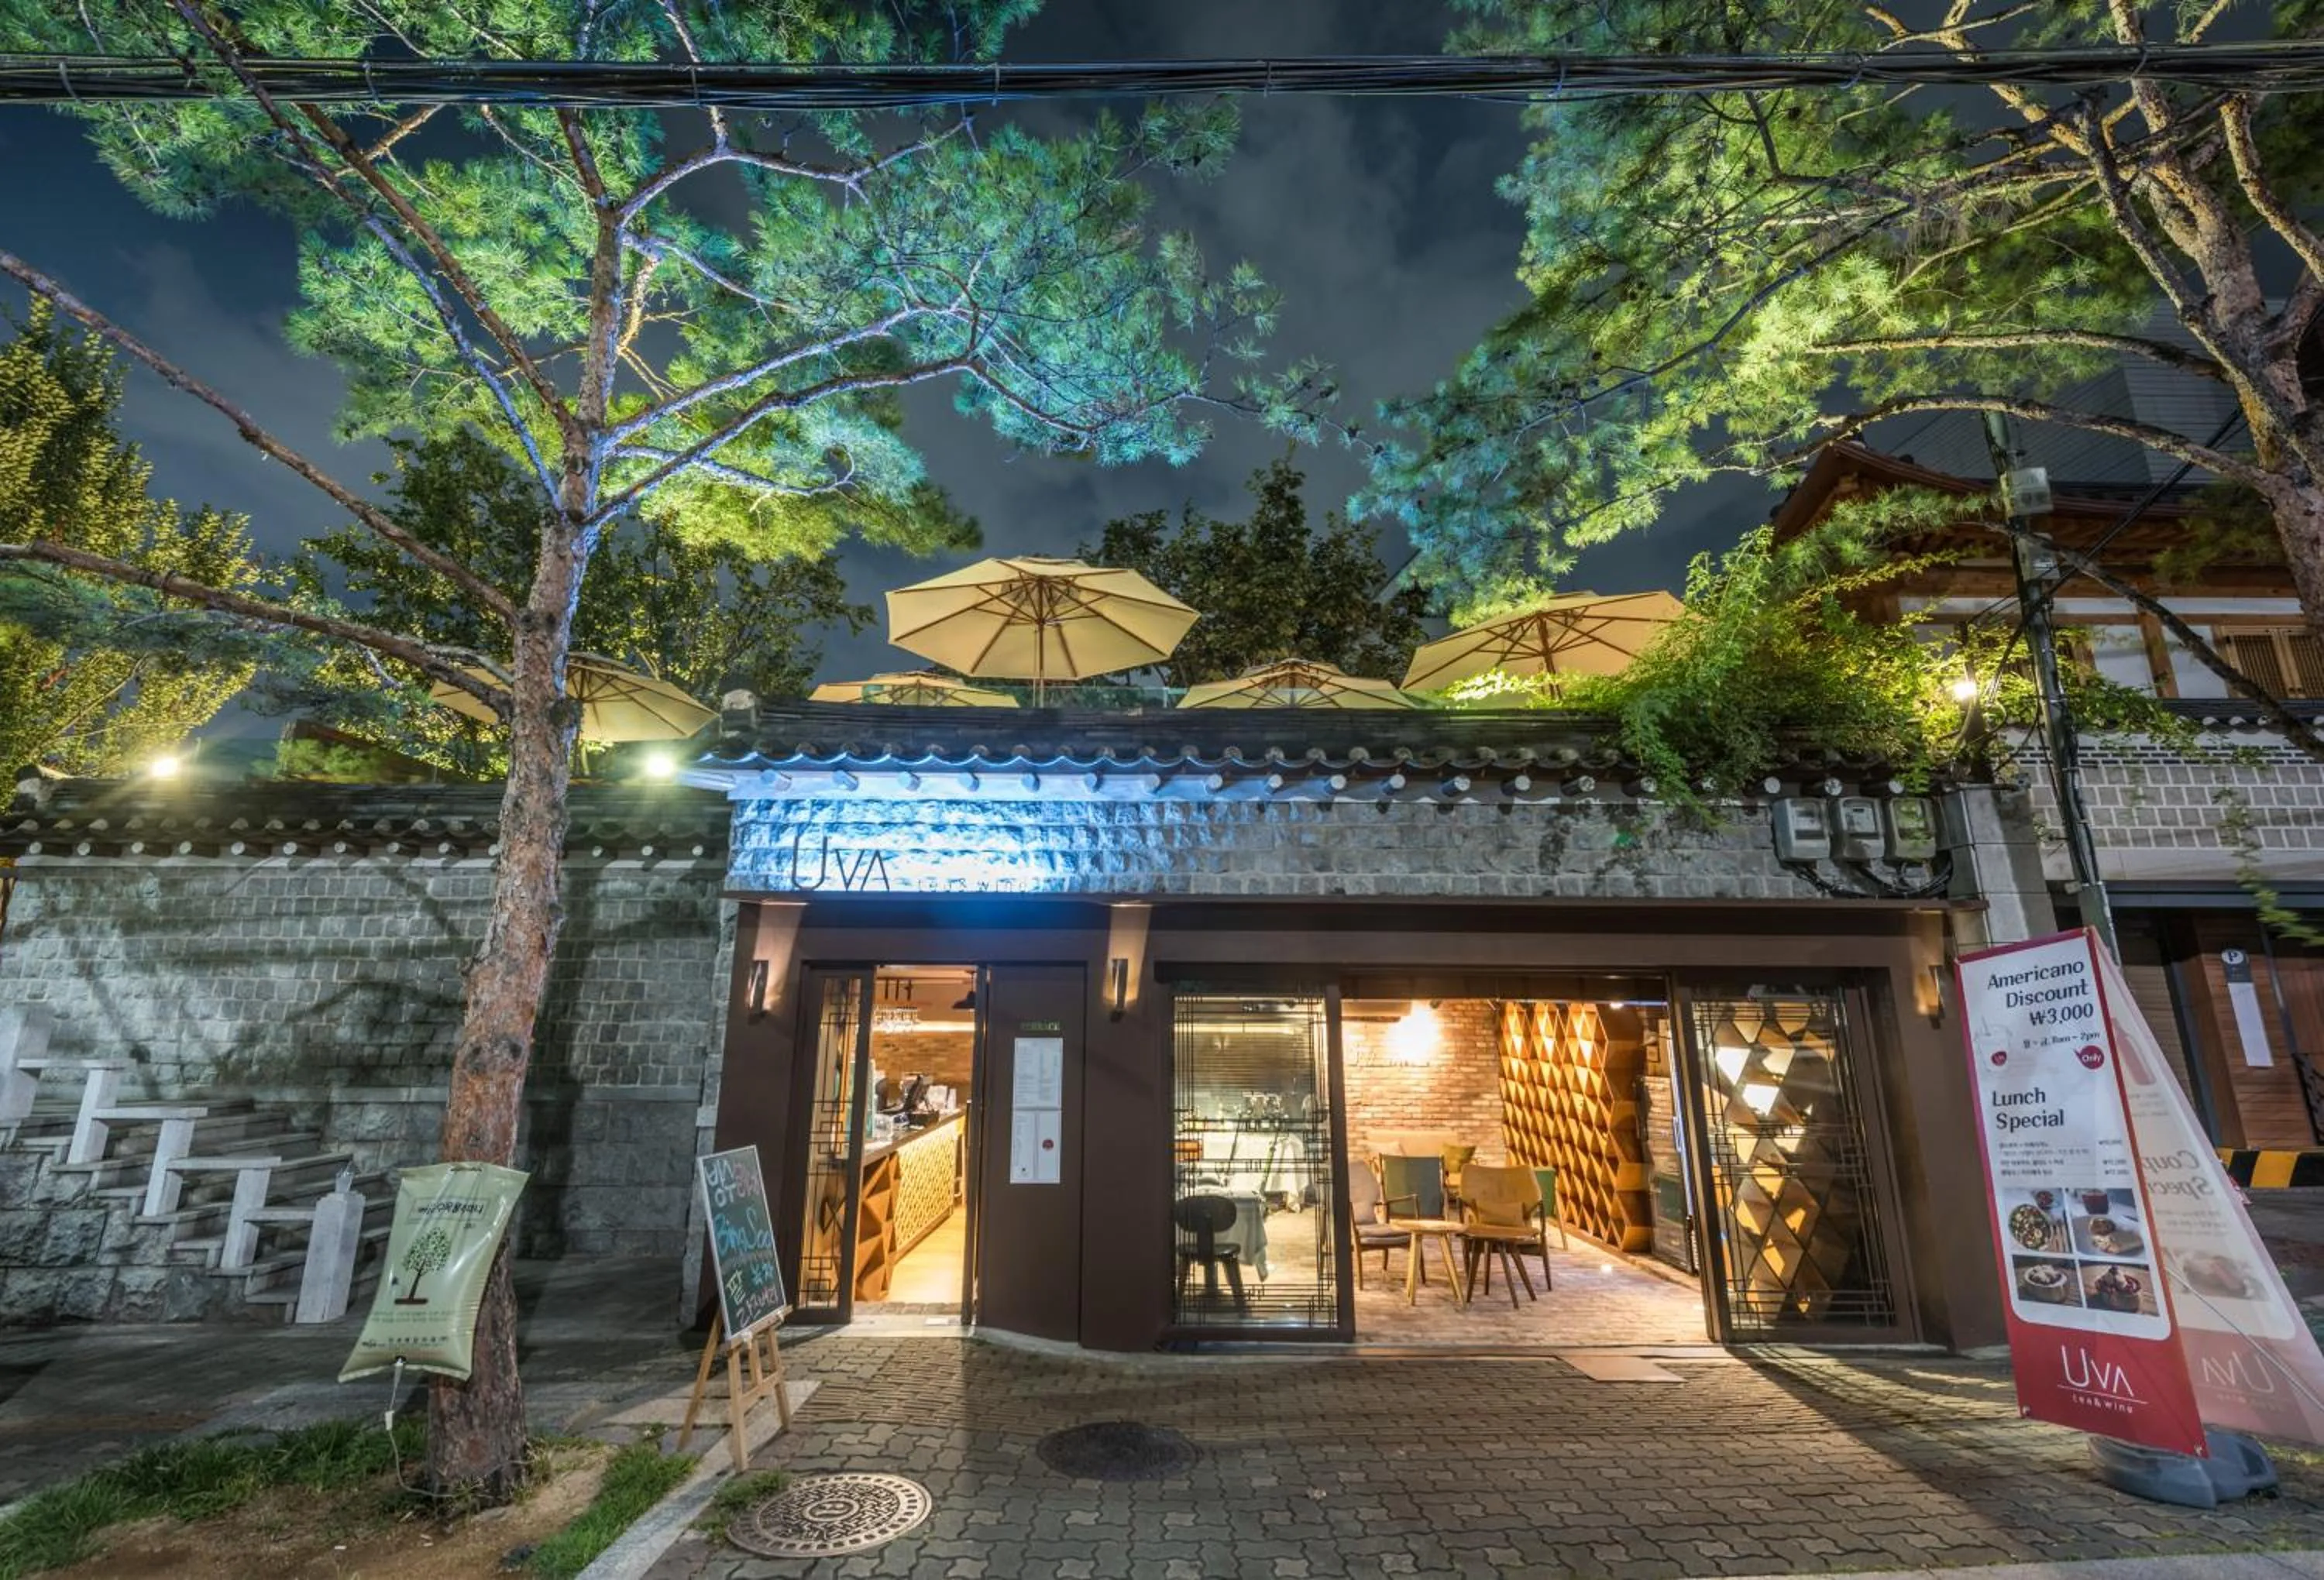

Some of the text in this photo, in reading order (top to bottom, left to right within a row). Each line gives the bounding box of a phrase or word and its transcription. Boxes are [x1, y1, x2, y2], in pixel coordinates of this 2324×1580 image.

[791, 836, 890, 892] UVA
[1987, 960, 2085, 990] Americano
[2006, 978, 2089, 1008] Discount
[2082, 1053, 2102, 1063] Only
[1992, 1087, 2046, 1108] Lunch
[1996, 1108, 2064, 1133] Special
[2061, 1345, 2135, 1397] UVA
